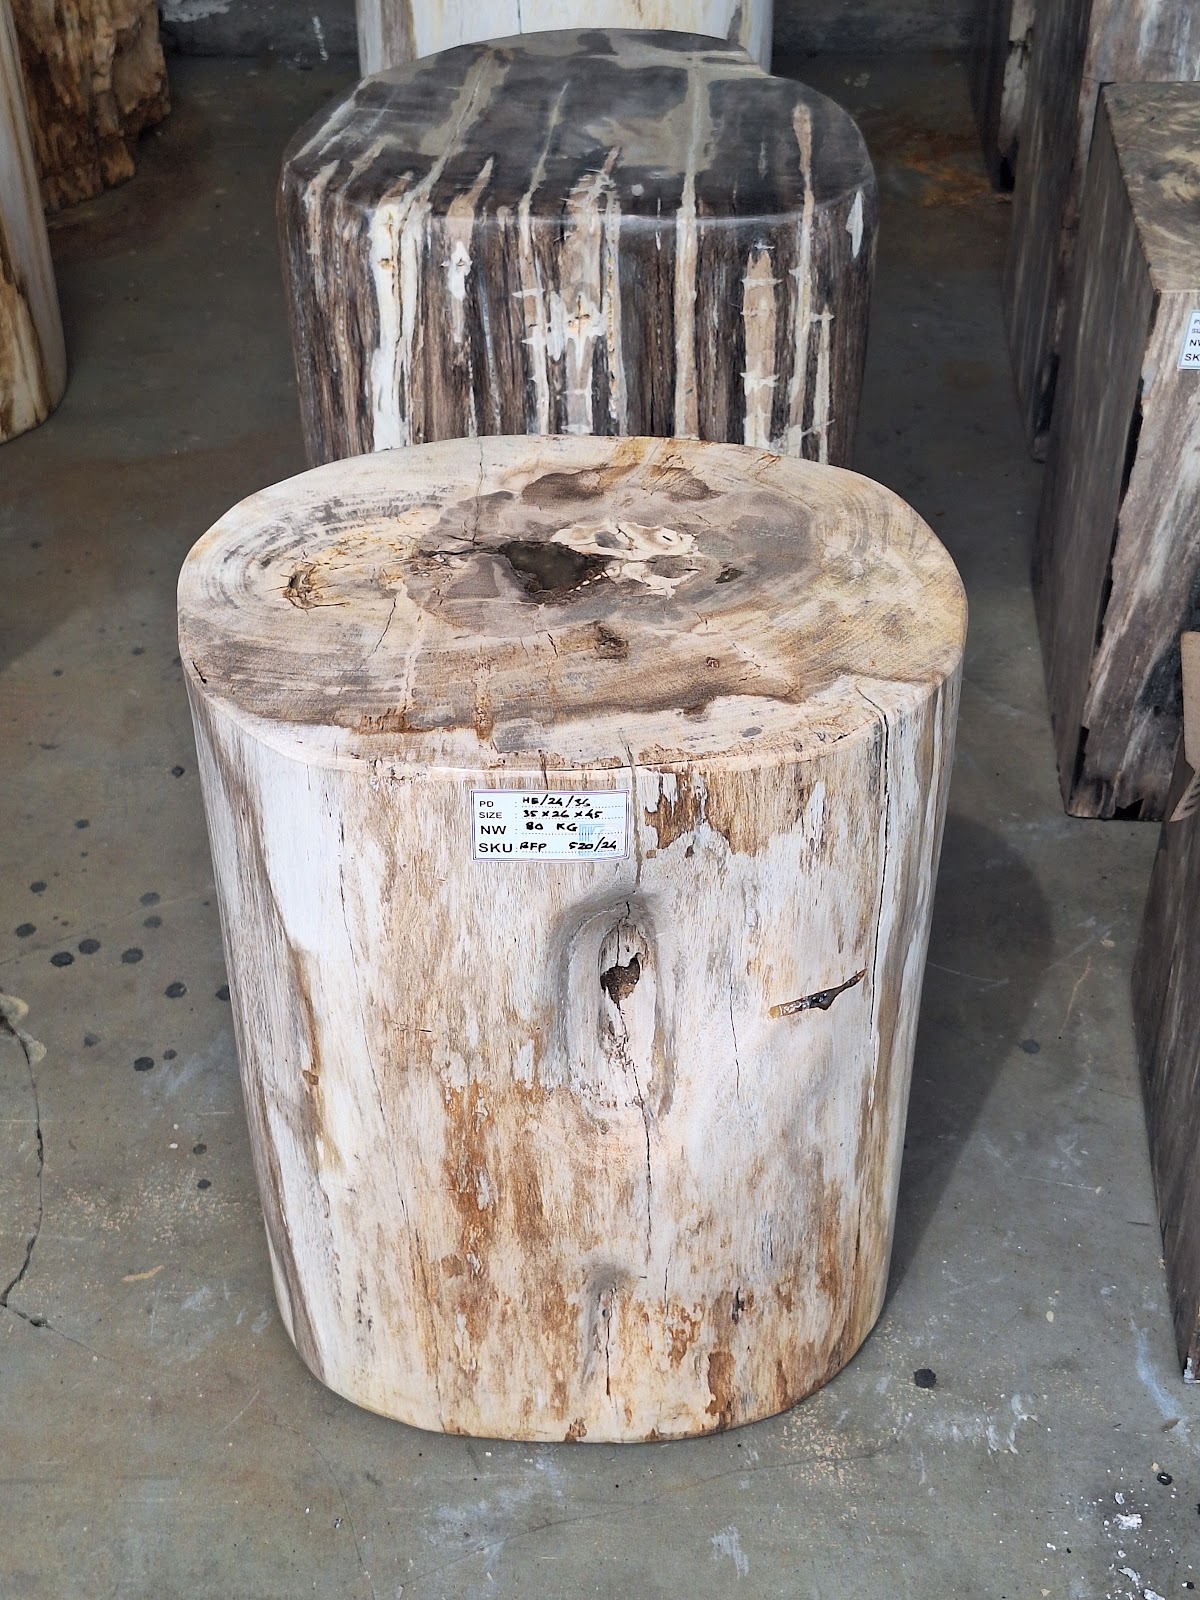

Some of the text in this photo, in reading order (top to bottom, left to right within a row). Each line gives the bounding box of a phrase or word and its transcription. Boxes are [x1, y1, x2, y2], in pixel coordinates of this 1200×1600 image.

[478, 811, 503, 819] SIZE
[480, 821, 578, 835] NW 80 KG
[478, 842, 513, 853] SKU
